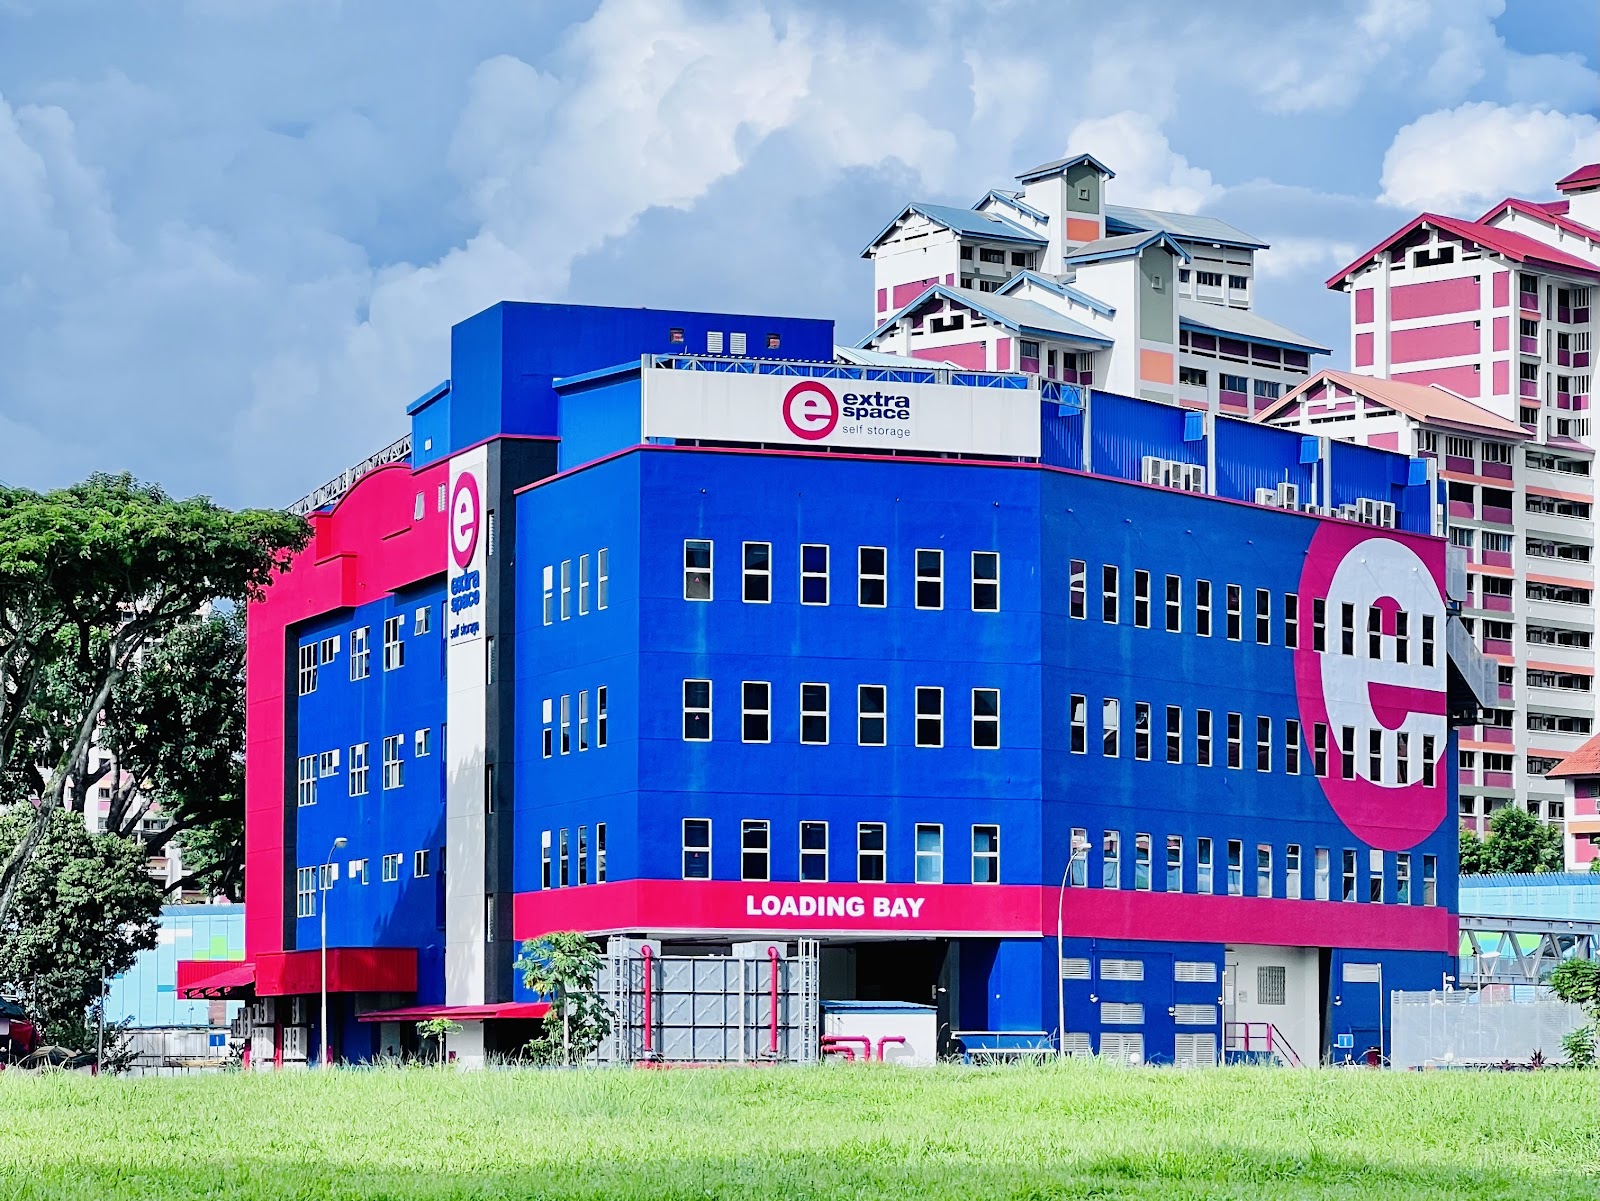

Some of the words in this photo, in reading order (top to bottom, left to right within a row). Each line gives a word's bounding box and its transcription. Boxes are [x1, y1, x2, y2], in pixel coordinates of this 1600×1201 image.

[842, 391, 910, 409] extra
[842, 406, 910, 421] space
[842, 424, 864, 434] self
[867, 426, 911, 438] storage
[451, 568, 480, 596] extra
[451, 589, 480, 616] space
[460, 621, 480, 637] storage
[746, 895, 865, 917] LOADING
[872, 897, 925, 918] BAY
